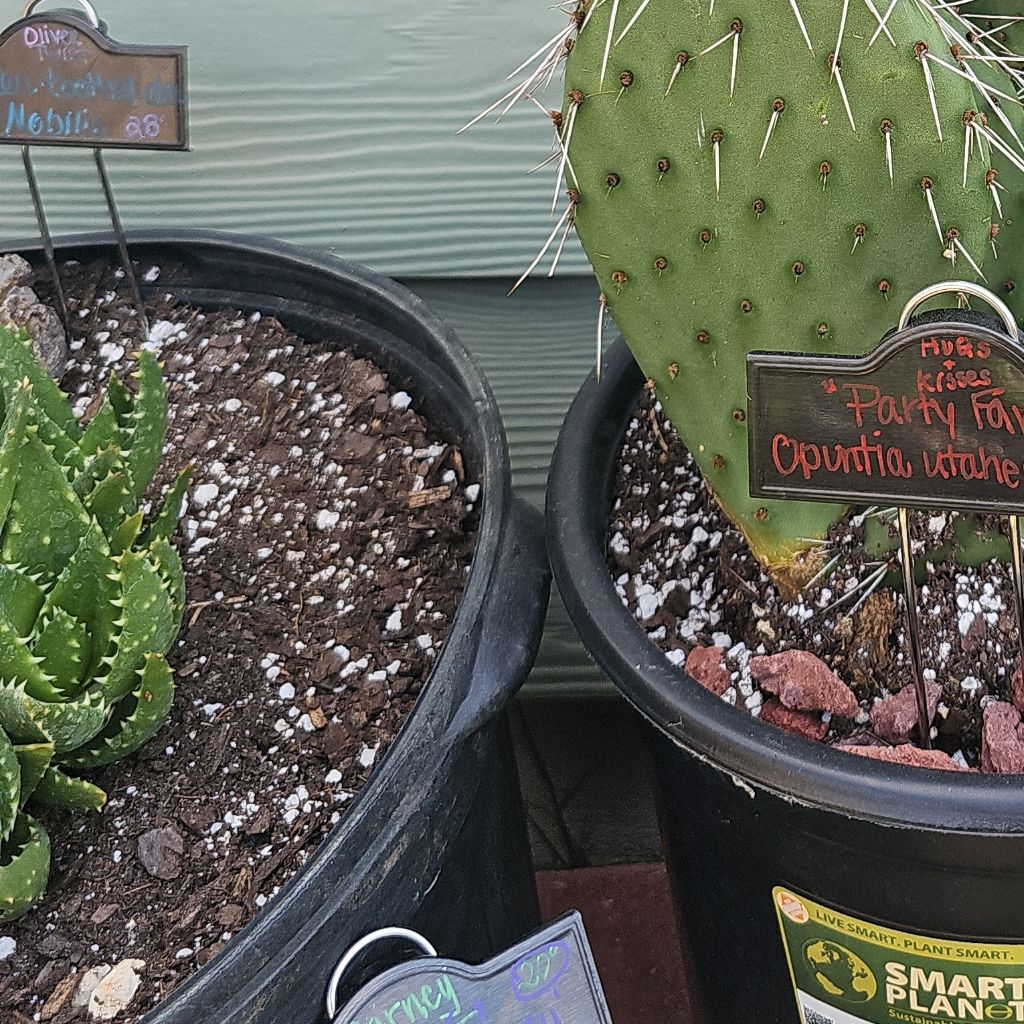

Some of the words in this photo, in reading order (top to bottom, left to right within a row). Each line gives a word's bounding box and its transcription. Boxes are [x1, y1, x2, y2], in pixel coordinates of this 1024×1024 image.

[772, 430, 912, 479] Opuntia
[815, 910, 845, 929] LIVE
[846, 922, 901, 947] SMART.
[903, 939, 953, 957] PLANT
[956, 947, 1014, 961] SMART.
